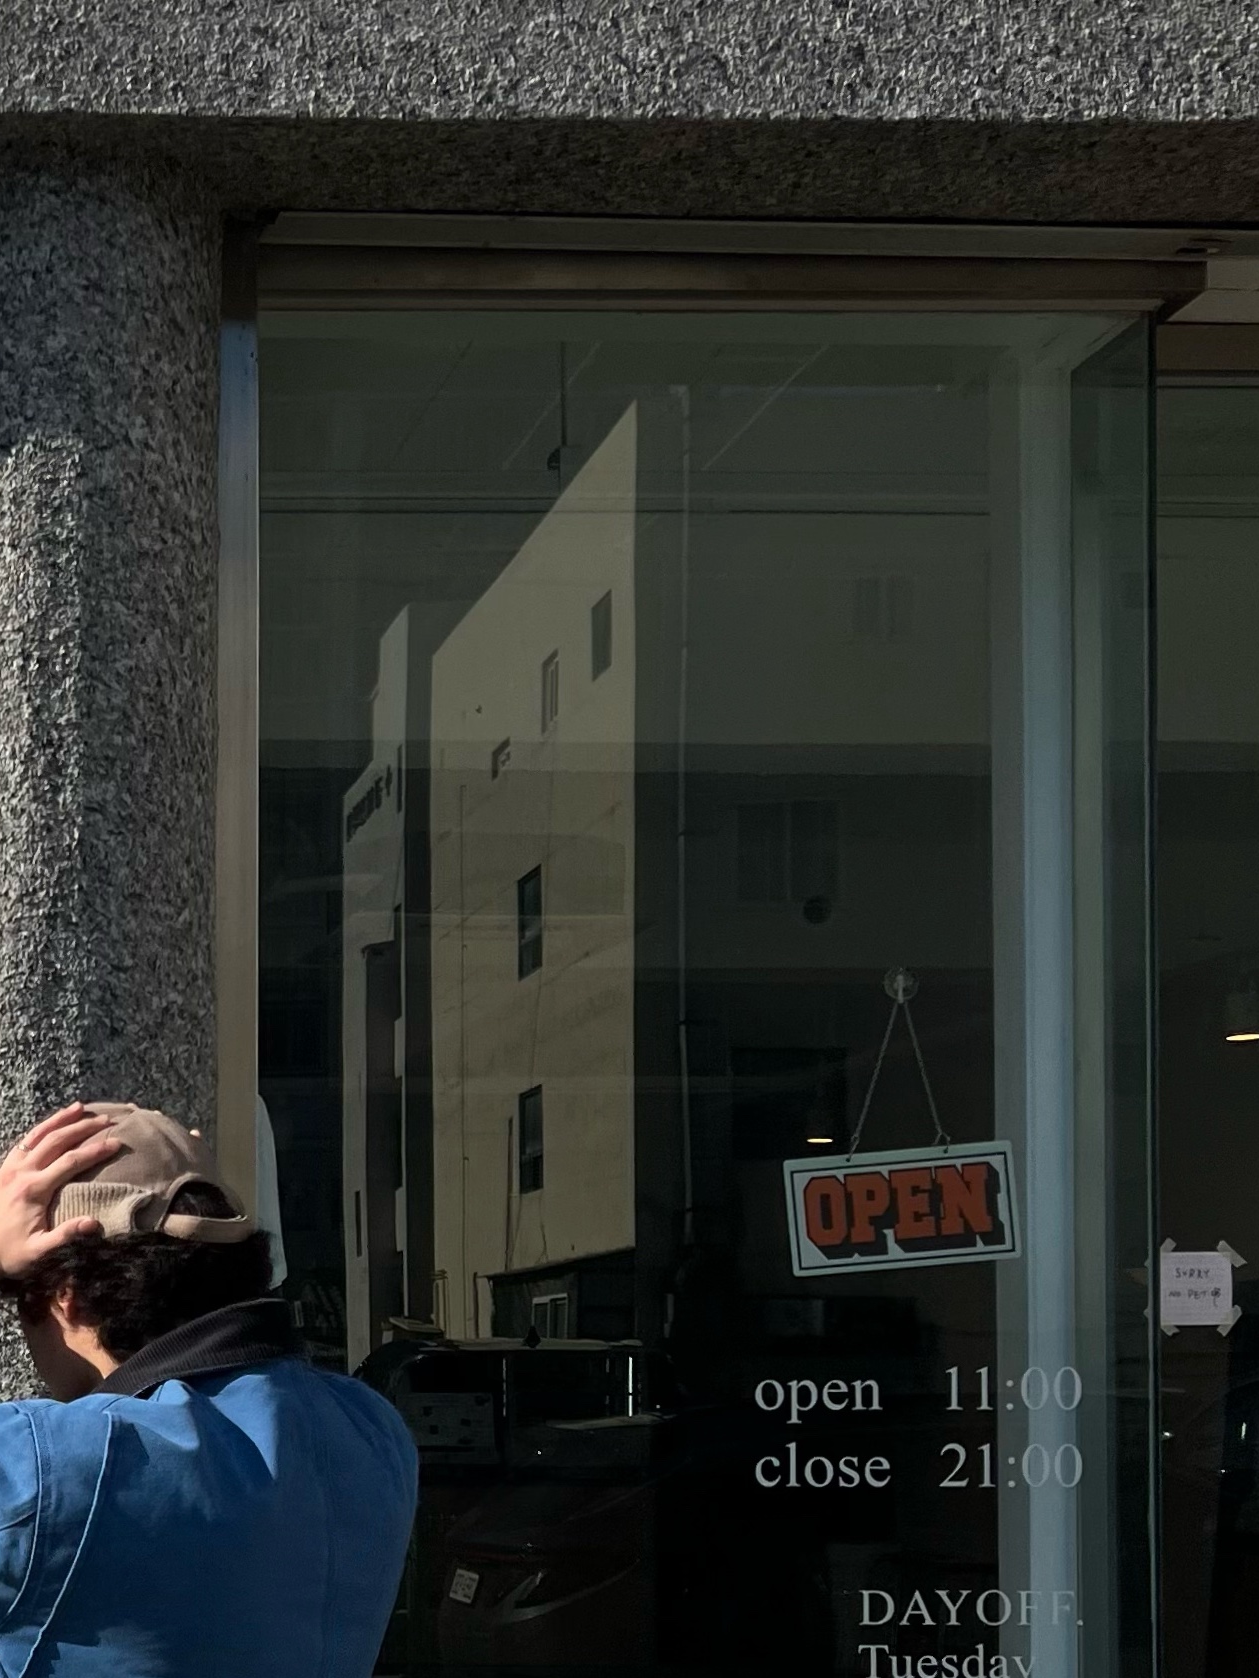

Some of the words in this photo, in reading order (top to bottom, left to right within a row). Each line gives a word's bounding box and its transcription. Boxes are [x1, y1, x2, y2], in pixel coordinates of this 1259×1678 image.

[803, 1161, 1002, 1259] OPEN
[754, 1377, 883, 1424] open
[944, 1366, 1083, 1412] 11:00
[754, 1443, 892, 1488] close
[938, 1443, 1083, 1488] 21:00
